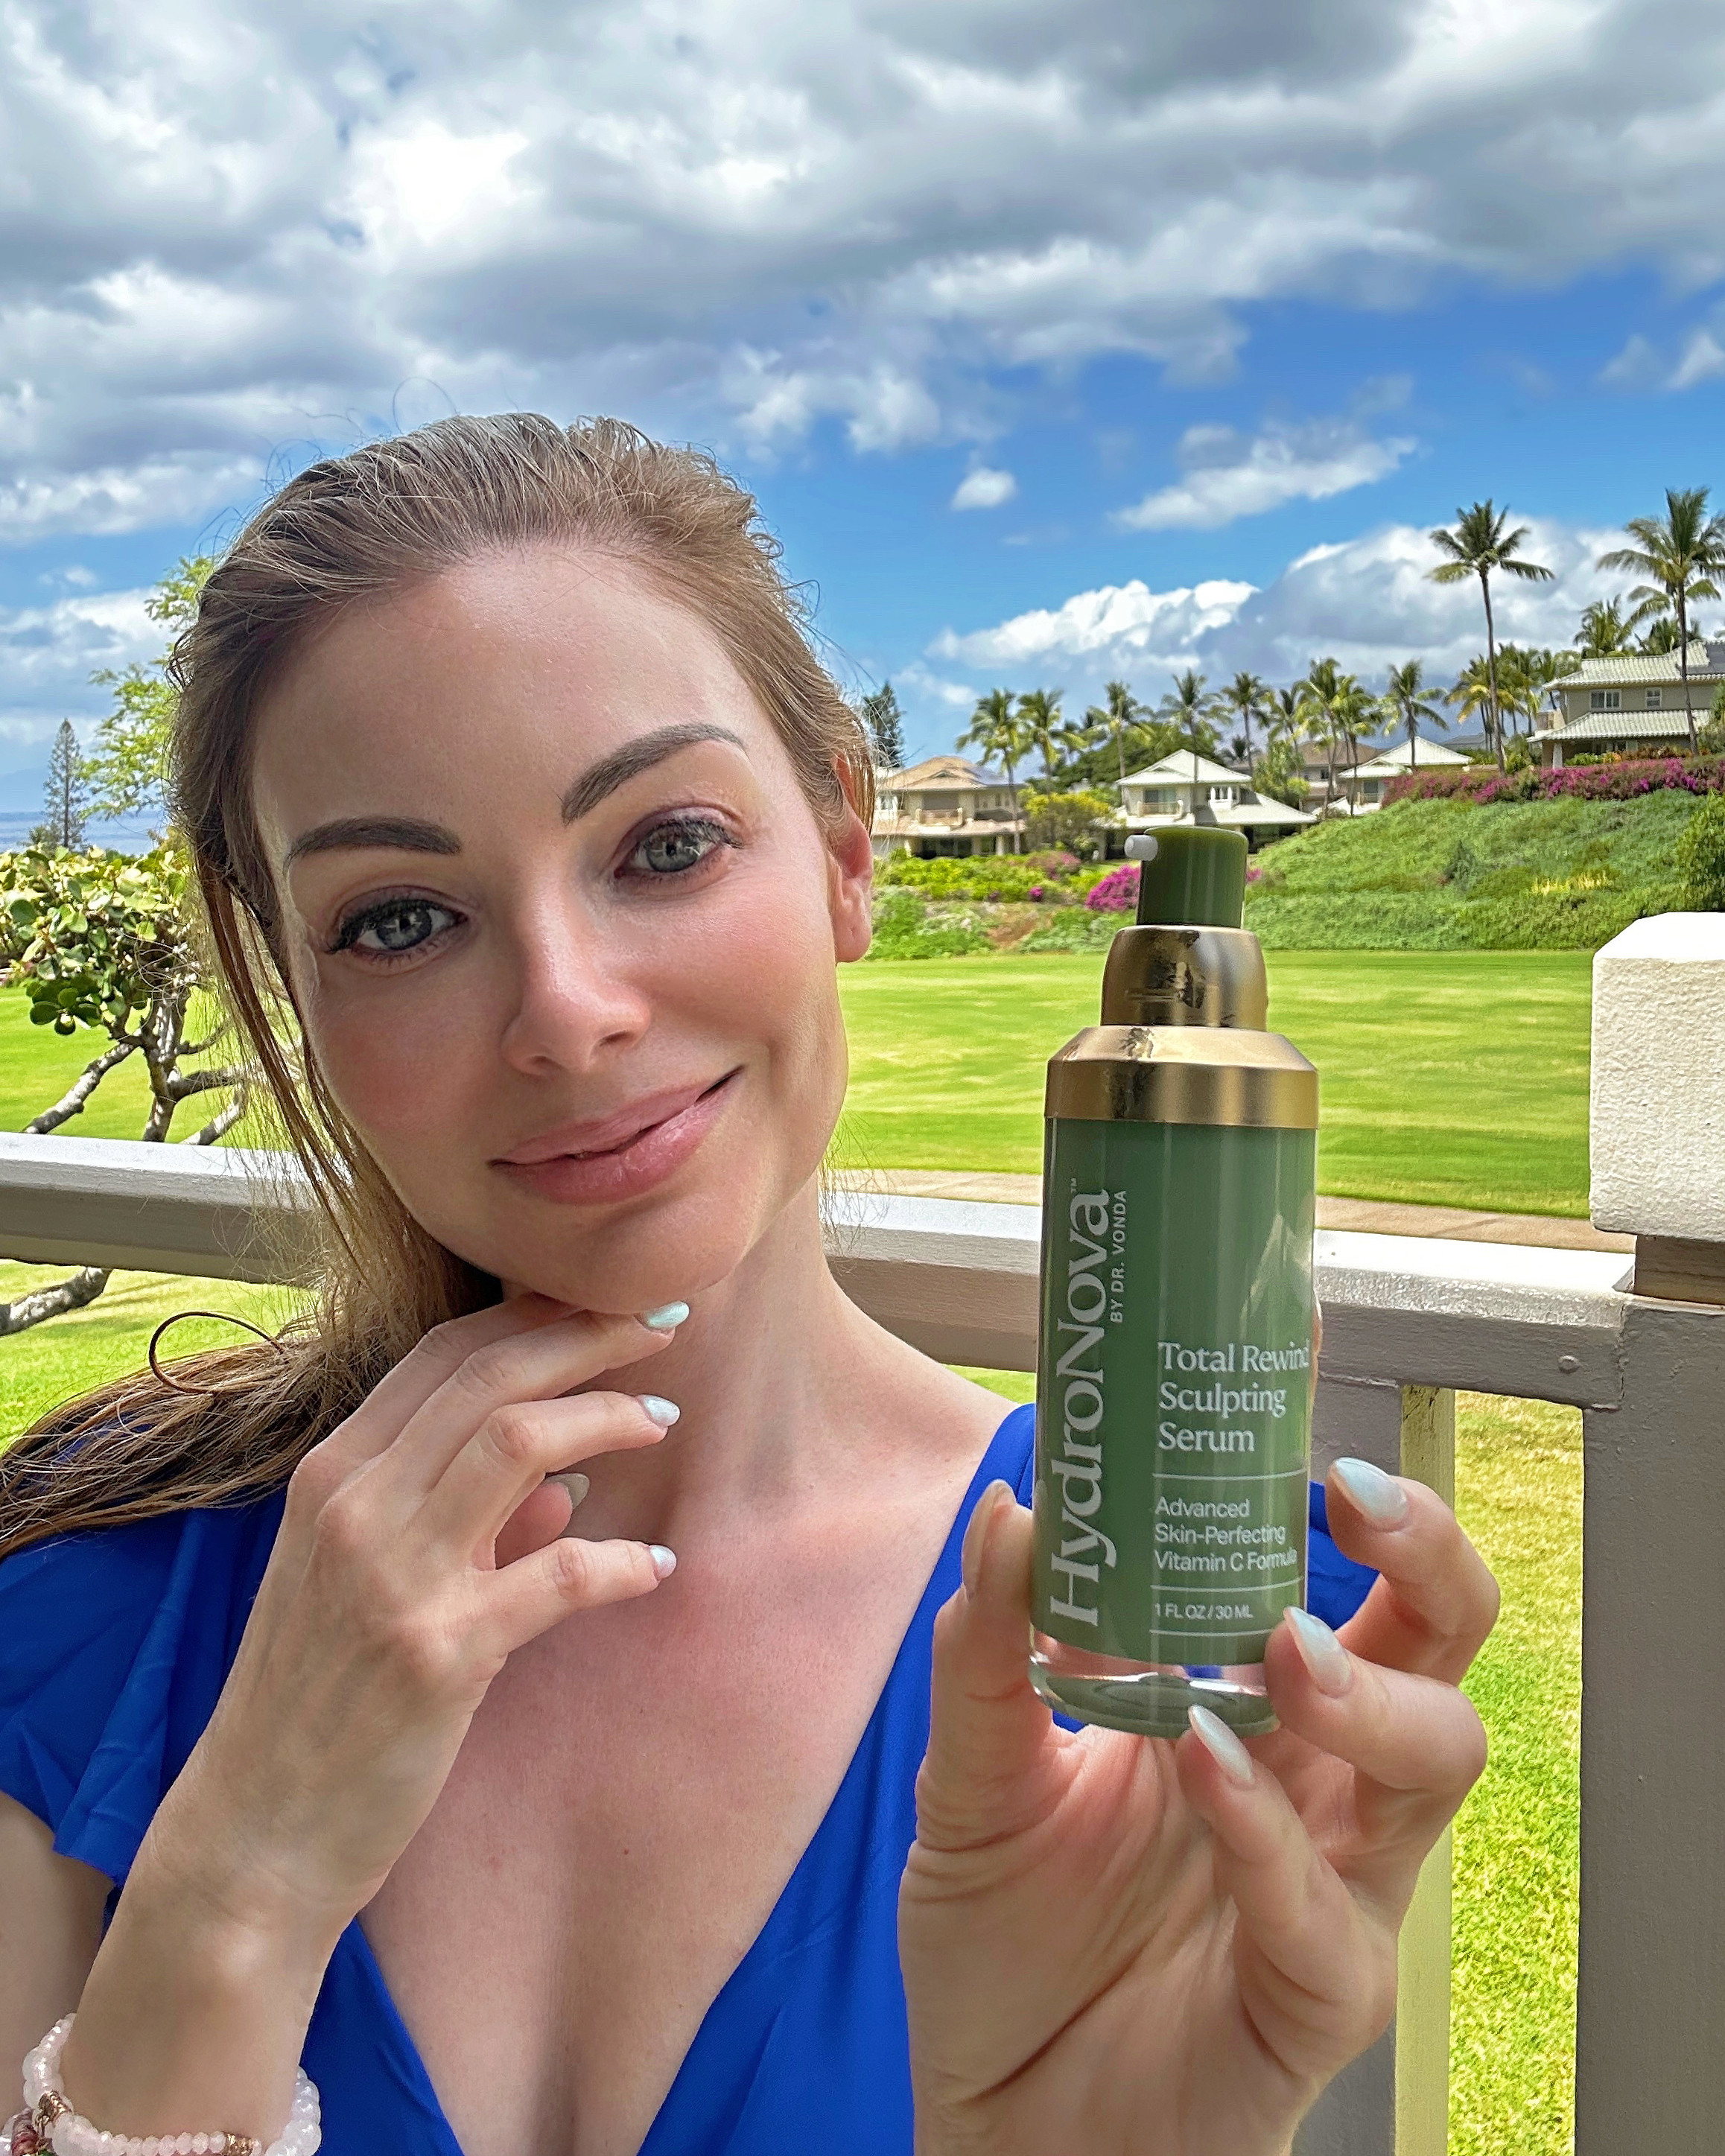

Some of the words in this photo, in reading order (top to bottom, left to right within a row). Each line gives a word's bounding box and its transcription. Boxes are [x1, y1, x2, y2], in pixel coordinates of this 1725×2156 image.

[1112, 1190, 1127, 1255] VONDA
[1111, 1262, 1125, 1293] DR.
[1110, 1299, 1124, 1323] BY
[1157, 1341, 1236, 1372] Total
[1242, 1338, 1309, 1372] Rewind
[1159, 1381, 1287, 1418] Sculpting
[1158, 1421, 1255, 1452] Serum
[1155, 1496, 1251, 1518] Advanced
[1155, 1523, 1286, 1545] Skin-Perfecting
[1154, 1549, 1226, 1571] Vitamin
[1230, 1551, 1244, 1571] C
[1248, 1547, 1297, 1571] Formula
[1154, 1603, 1161, 1617] 1
[1166, 1603, 1184, 1618] FL
[1234, 1605, 1254, 1619] ML
